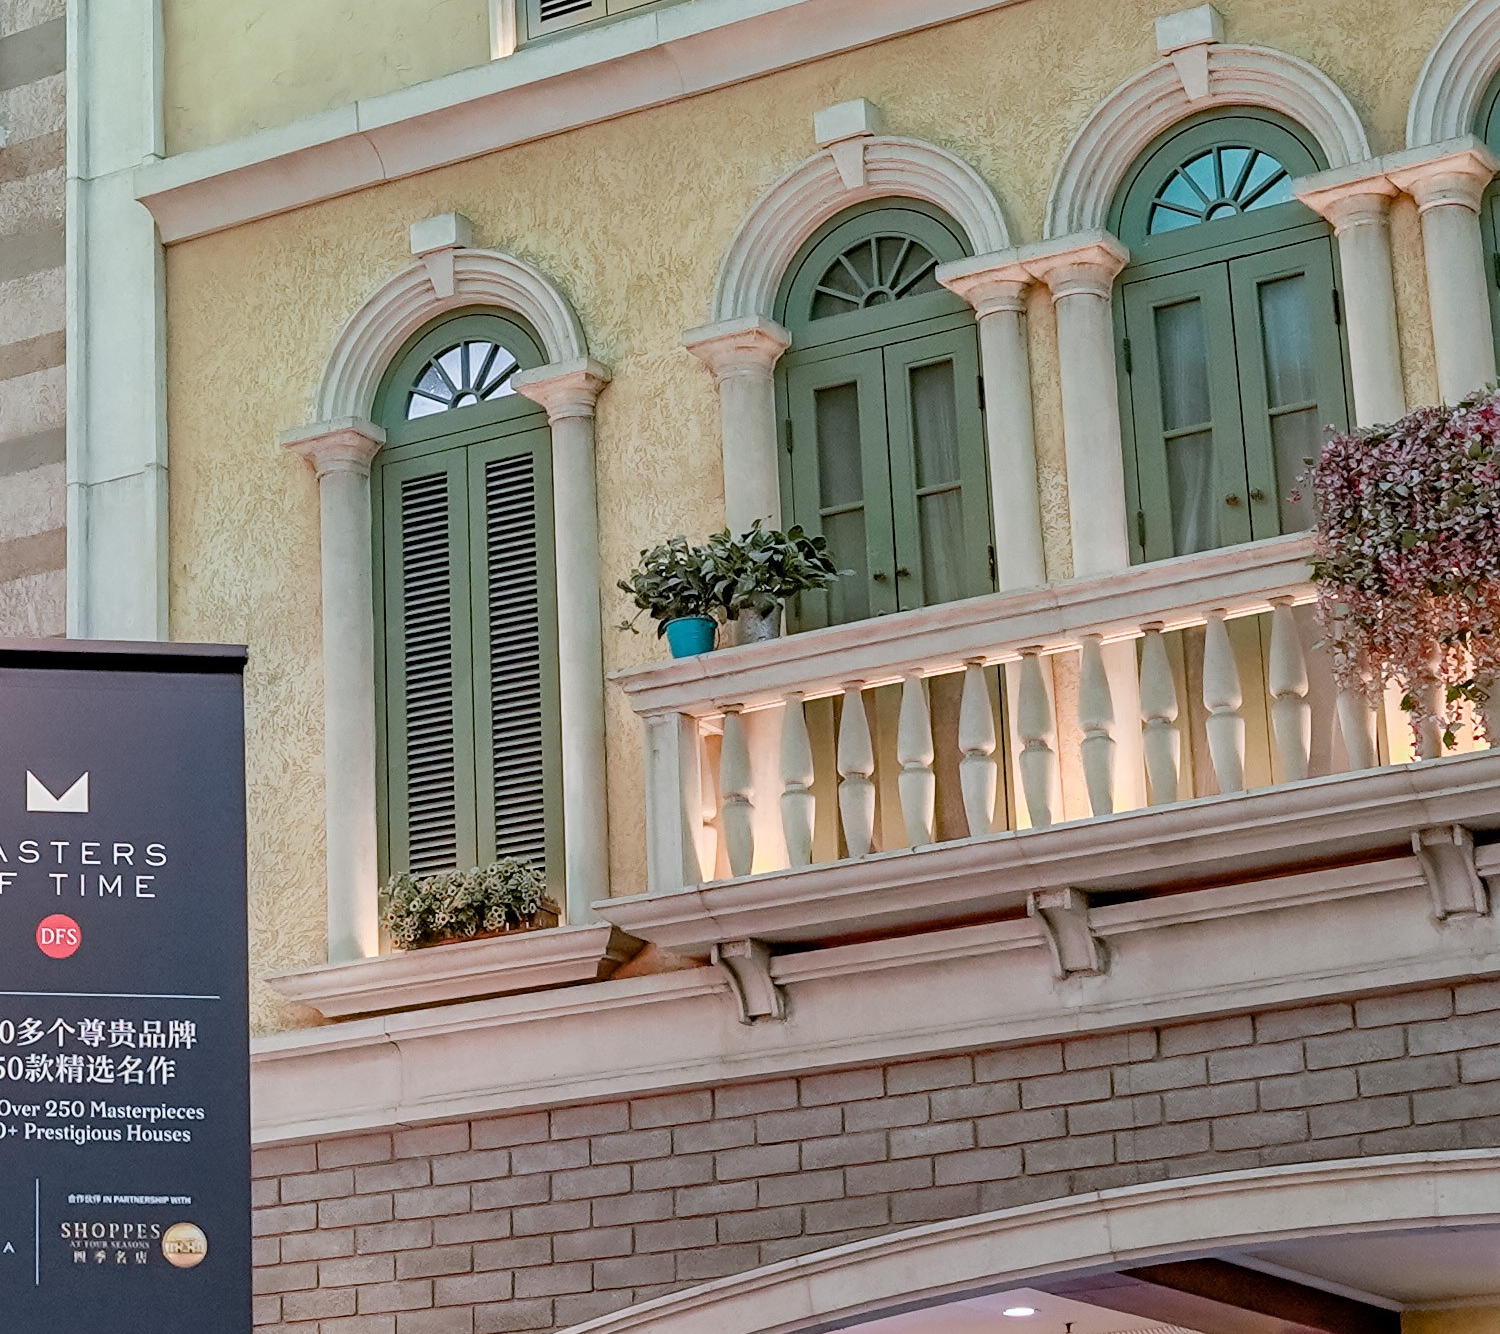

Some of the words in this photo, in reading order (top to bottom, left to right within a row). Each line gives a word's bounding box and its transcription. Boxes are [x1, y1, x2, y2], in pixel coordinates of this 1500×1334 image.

[48, 872, 156, 898] TIME
[40, 926, 79, 946] DFS
[44, 1100, 86, 1118] 250
[89, 1101, 206, 1123] Masterpieces
[23, 1121, 123, 1145] Prestigious
[126, 1124, 192, 1143] Houses
[102, 1195, 113, 1205] IN
[113, 1195, 170, 1205] PARTNERSHIP
[170, 1196, 192, 1205] WITH
[60, 1221, 162, 1241] SHOPPES
